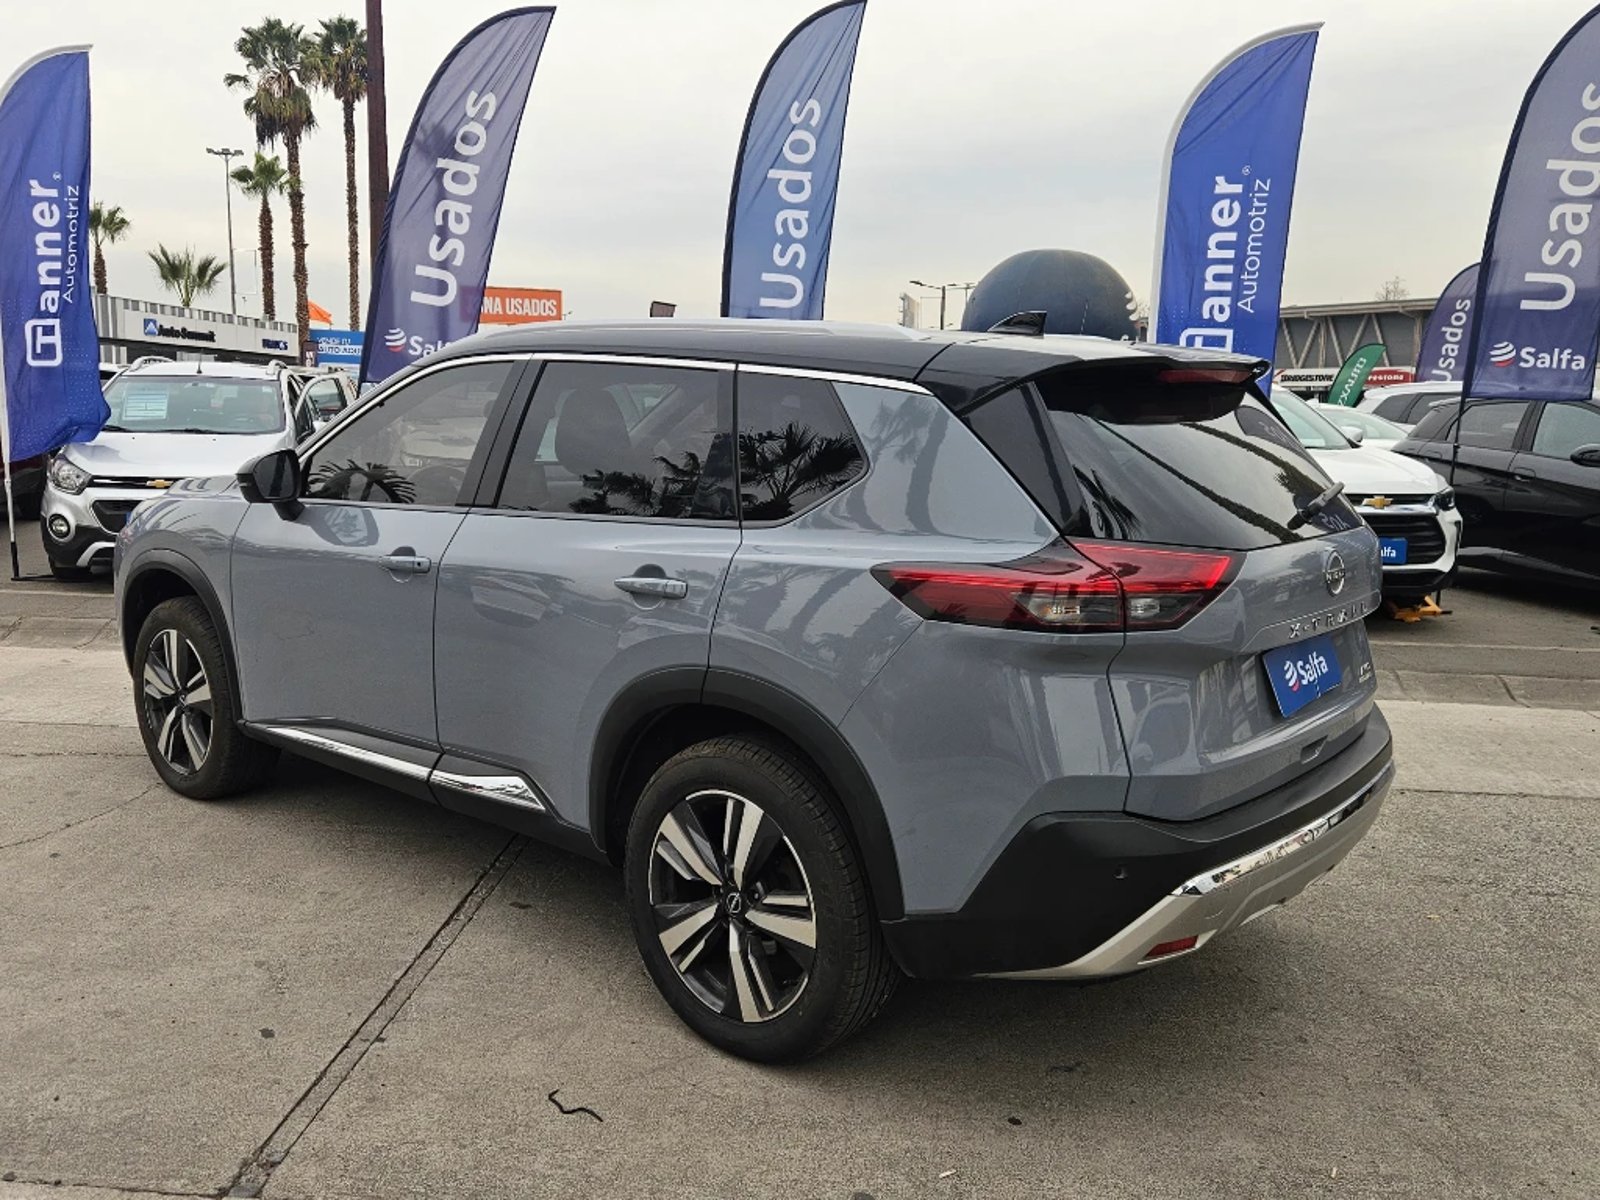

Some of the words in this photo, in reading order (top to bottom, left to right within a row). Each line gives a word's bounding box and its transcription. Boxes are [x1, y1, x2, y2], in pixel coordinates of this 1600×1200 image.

[410, 89, 497, 308] Usados
[759, 98, 822, 309] Usados
[62, 185, 79, 304] Automotriz
[1237, 178, 1271, 313] Automotriz
[505, 297, 557, 316] USADOS
[1431, 298, 1471, 382] Usados
[1518, 346, 1585, 371] Salfa
[1280, 373, 1334, 383] BRIDGESTONE
[1288, 601, 1368, 639] X-TRAIL
[1296, 650, 1329, 686] Salfa
